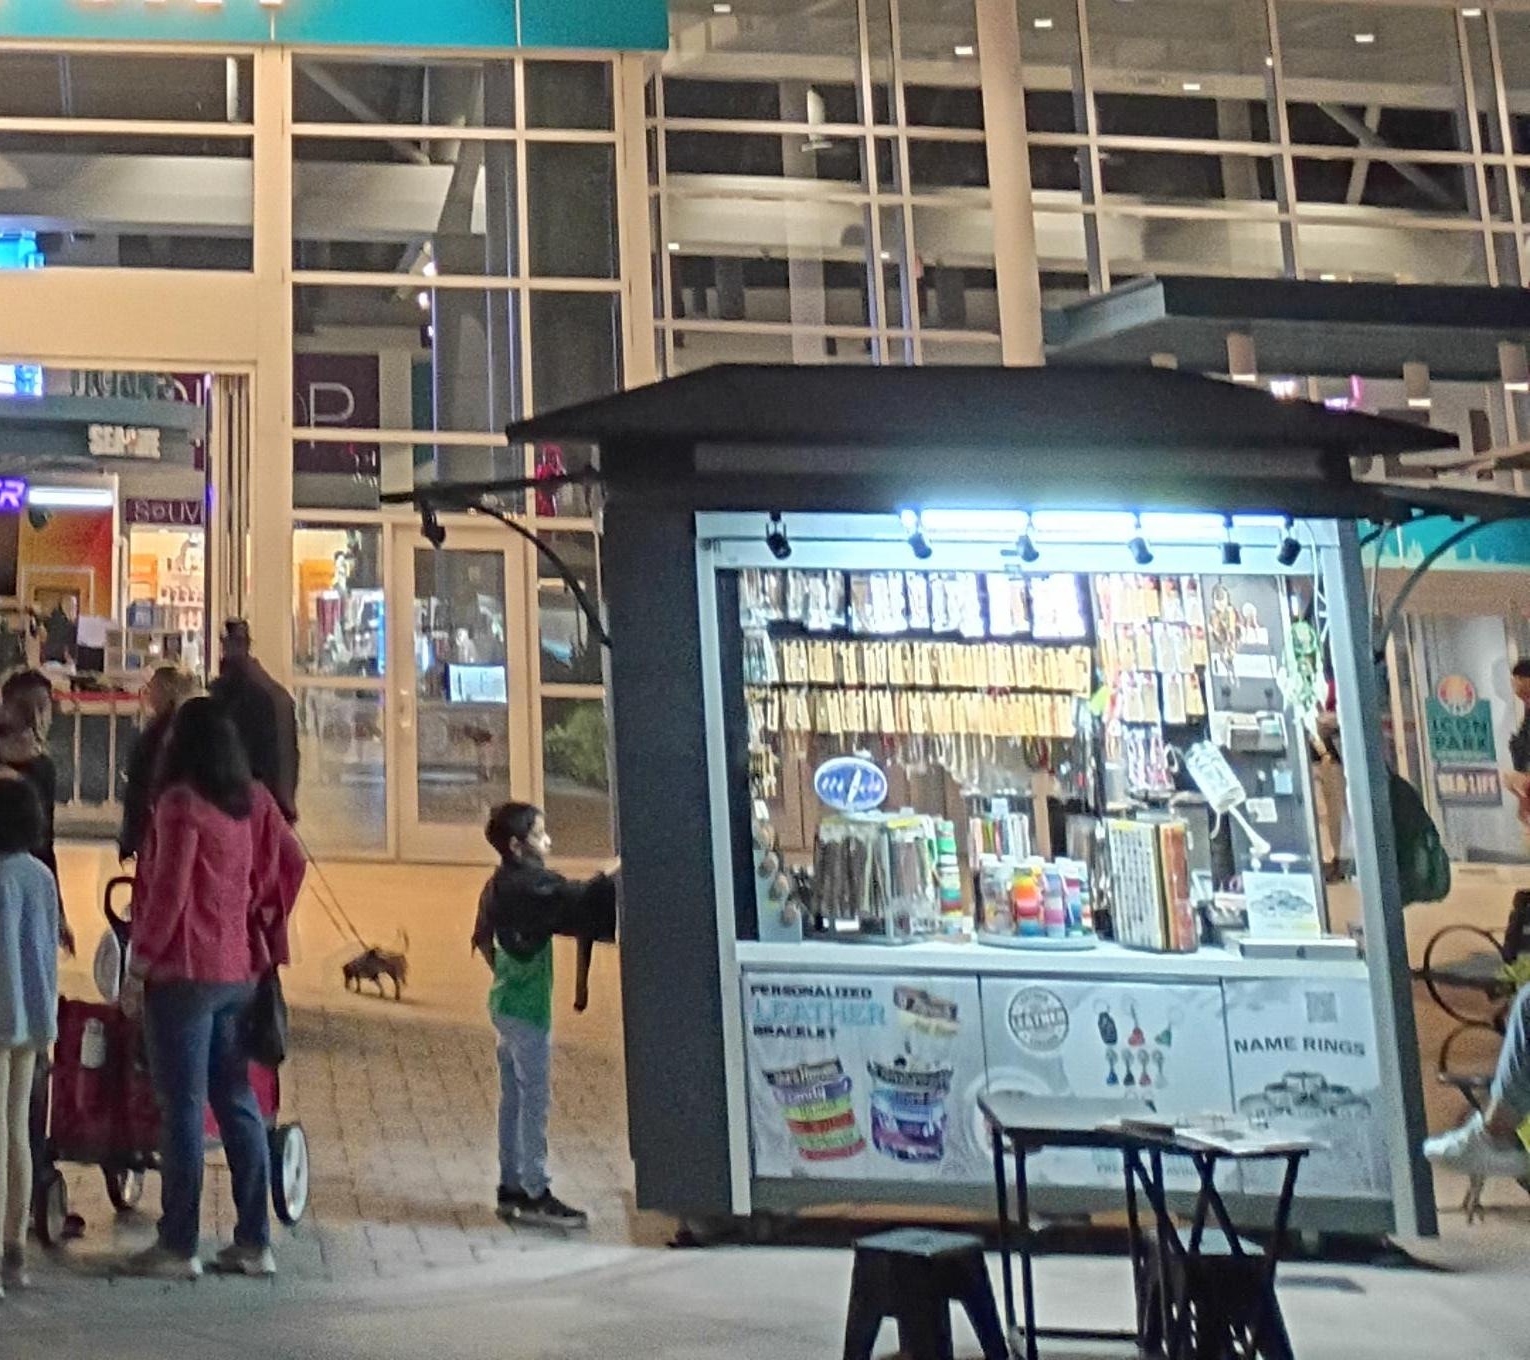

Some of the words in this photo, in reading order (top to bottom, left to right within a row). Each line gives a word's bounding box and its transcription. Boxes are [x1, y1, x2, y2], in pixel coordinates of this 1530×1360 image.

[750, 984, 872, 999] PERSONALIZED
[754, 999, 886, 1026] LEATHER
[752, 1025, 837, 1039] BRACELET
[1233, 1036, 1298, 1054] NAME
[1302, 1037, 1366, 1057] RINGS
